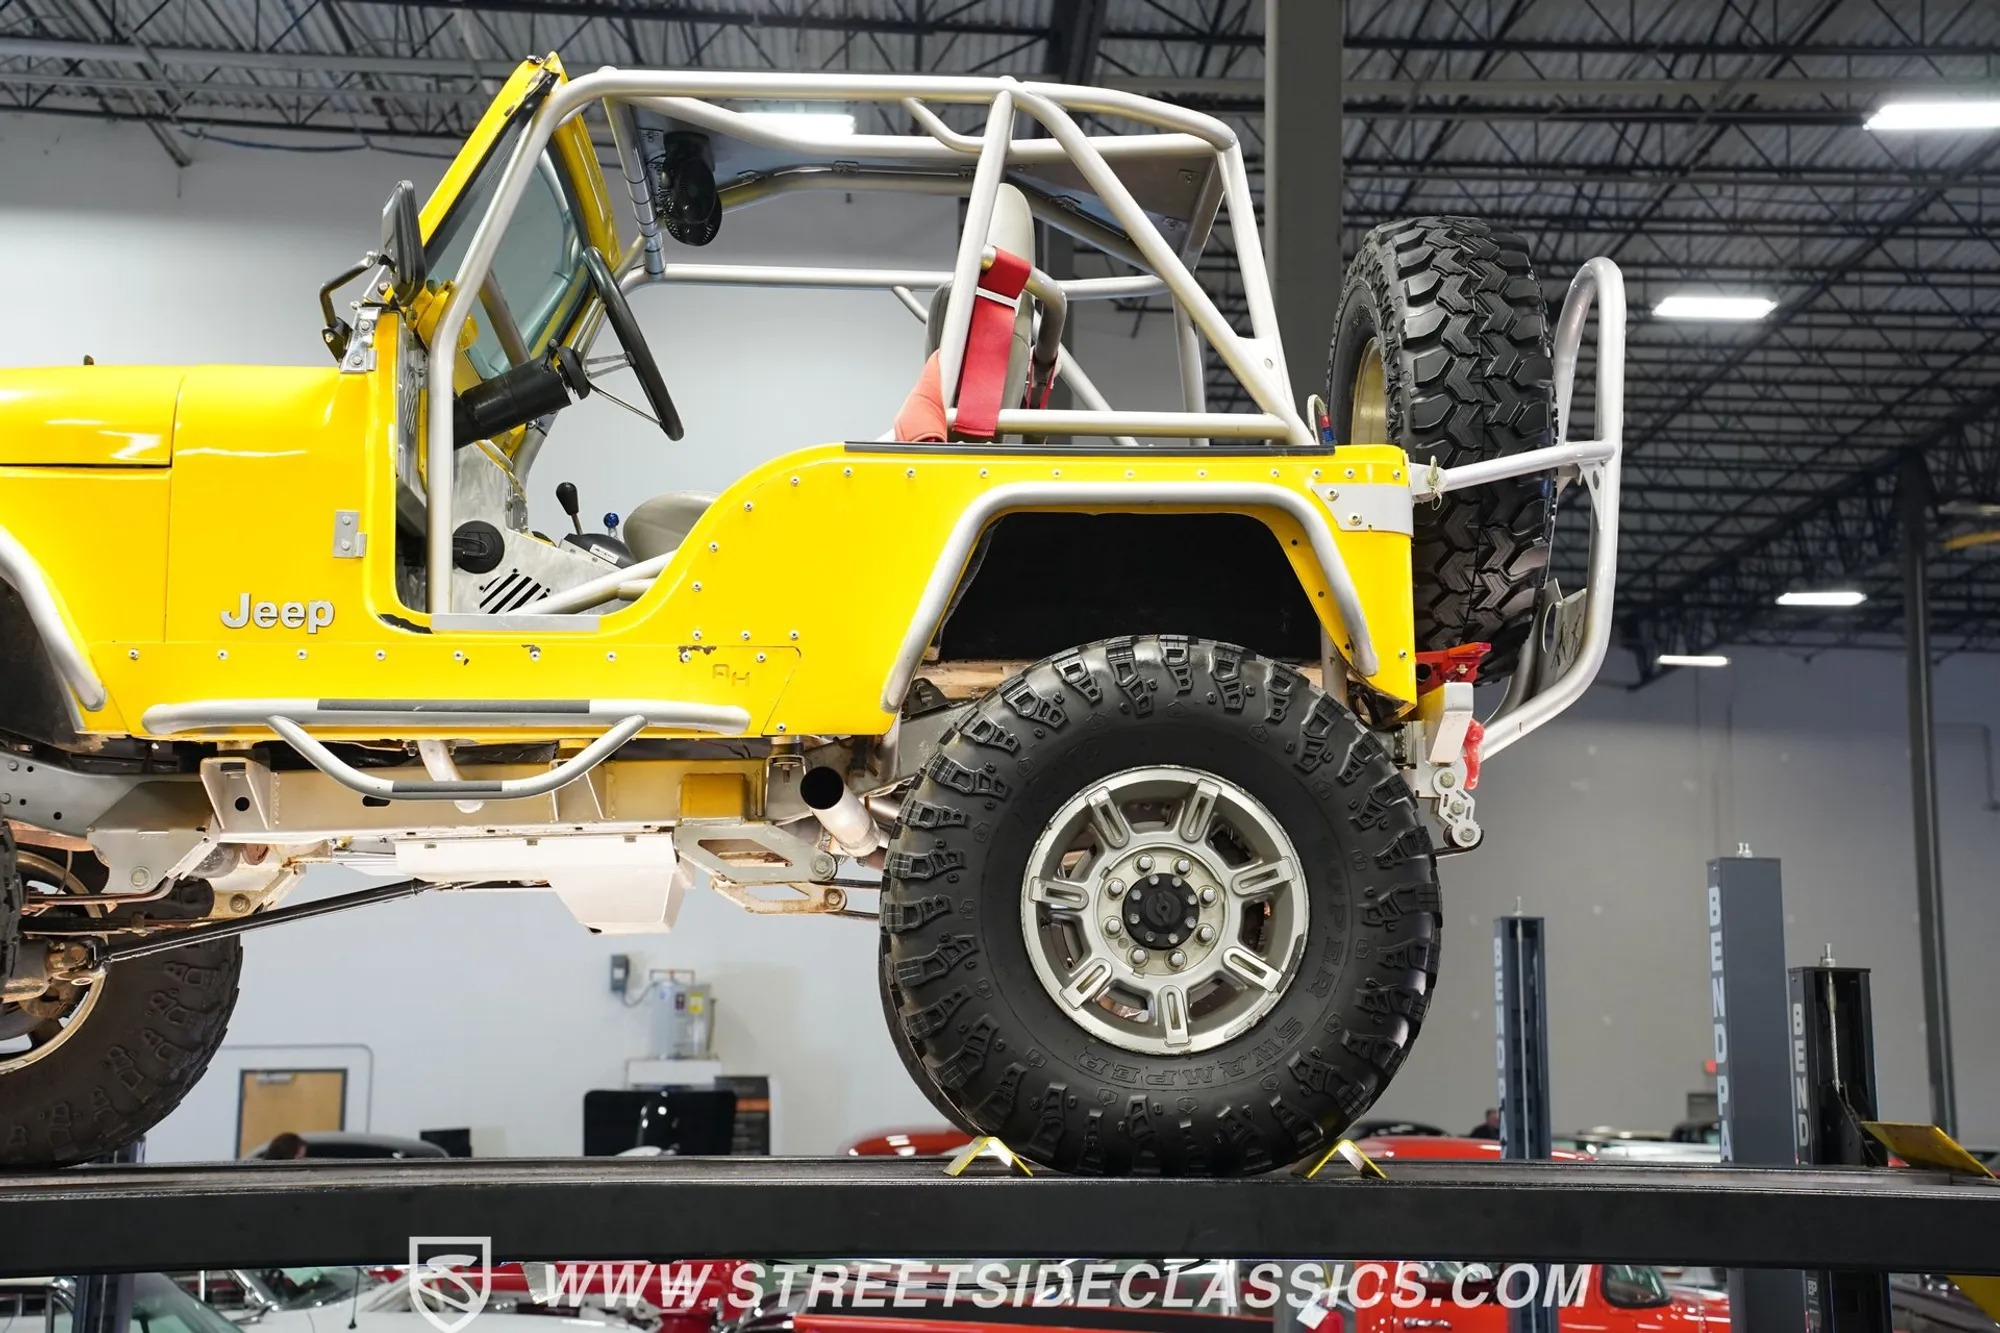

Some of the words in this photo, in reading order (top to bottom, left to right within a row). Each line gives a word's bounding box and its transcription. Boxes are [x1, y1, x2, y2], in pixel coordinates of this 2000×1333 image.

[219, 592, 336, 634] Jeep
[1074, 1016, 1304, 1087] SWAMPER
[1792, 1003, 1811, 1163] BEND
